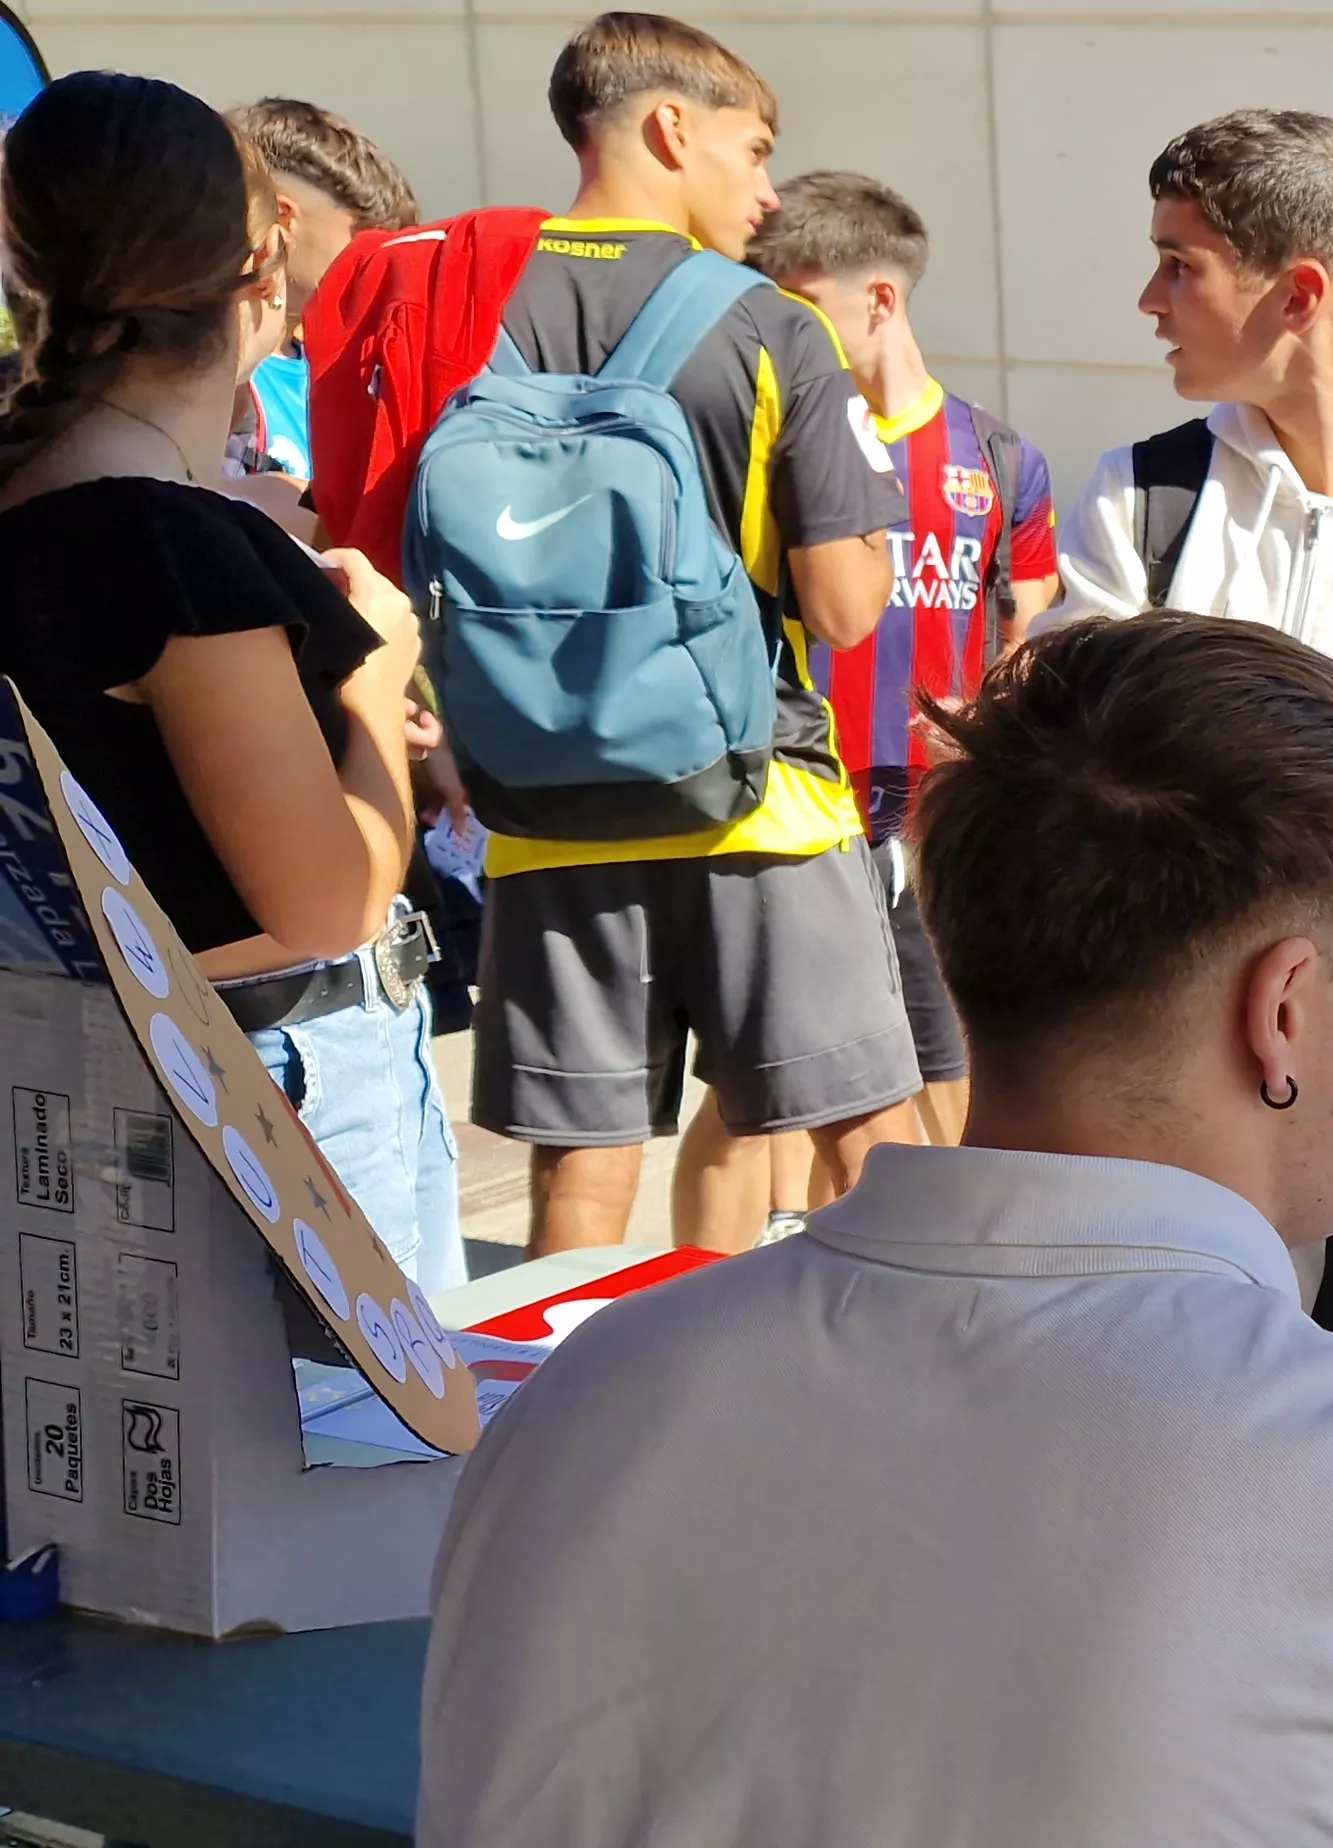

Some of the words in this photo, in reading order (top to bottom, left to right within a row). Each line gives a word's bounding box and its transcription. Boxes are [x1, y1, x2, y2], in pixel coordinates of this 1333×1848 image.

[34, 1093, 50, 1201] Laminado
[54, 1150, 69, 1205] Seco
[24, 1289, 36, 1340] Tamaño
[59, 1328, 73, 1351] 23
[60, 1311, 72, 1323] x
[45, 1423, 64, 1458] 20
[65, 1402, 81, 1494] Paquetes
[144, 1471, 159, 1510] Dos
[158, 1458, 176, 1513] Hojas
